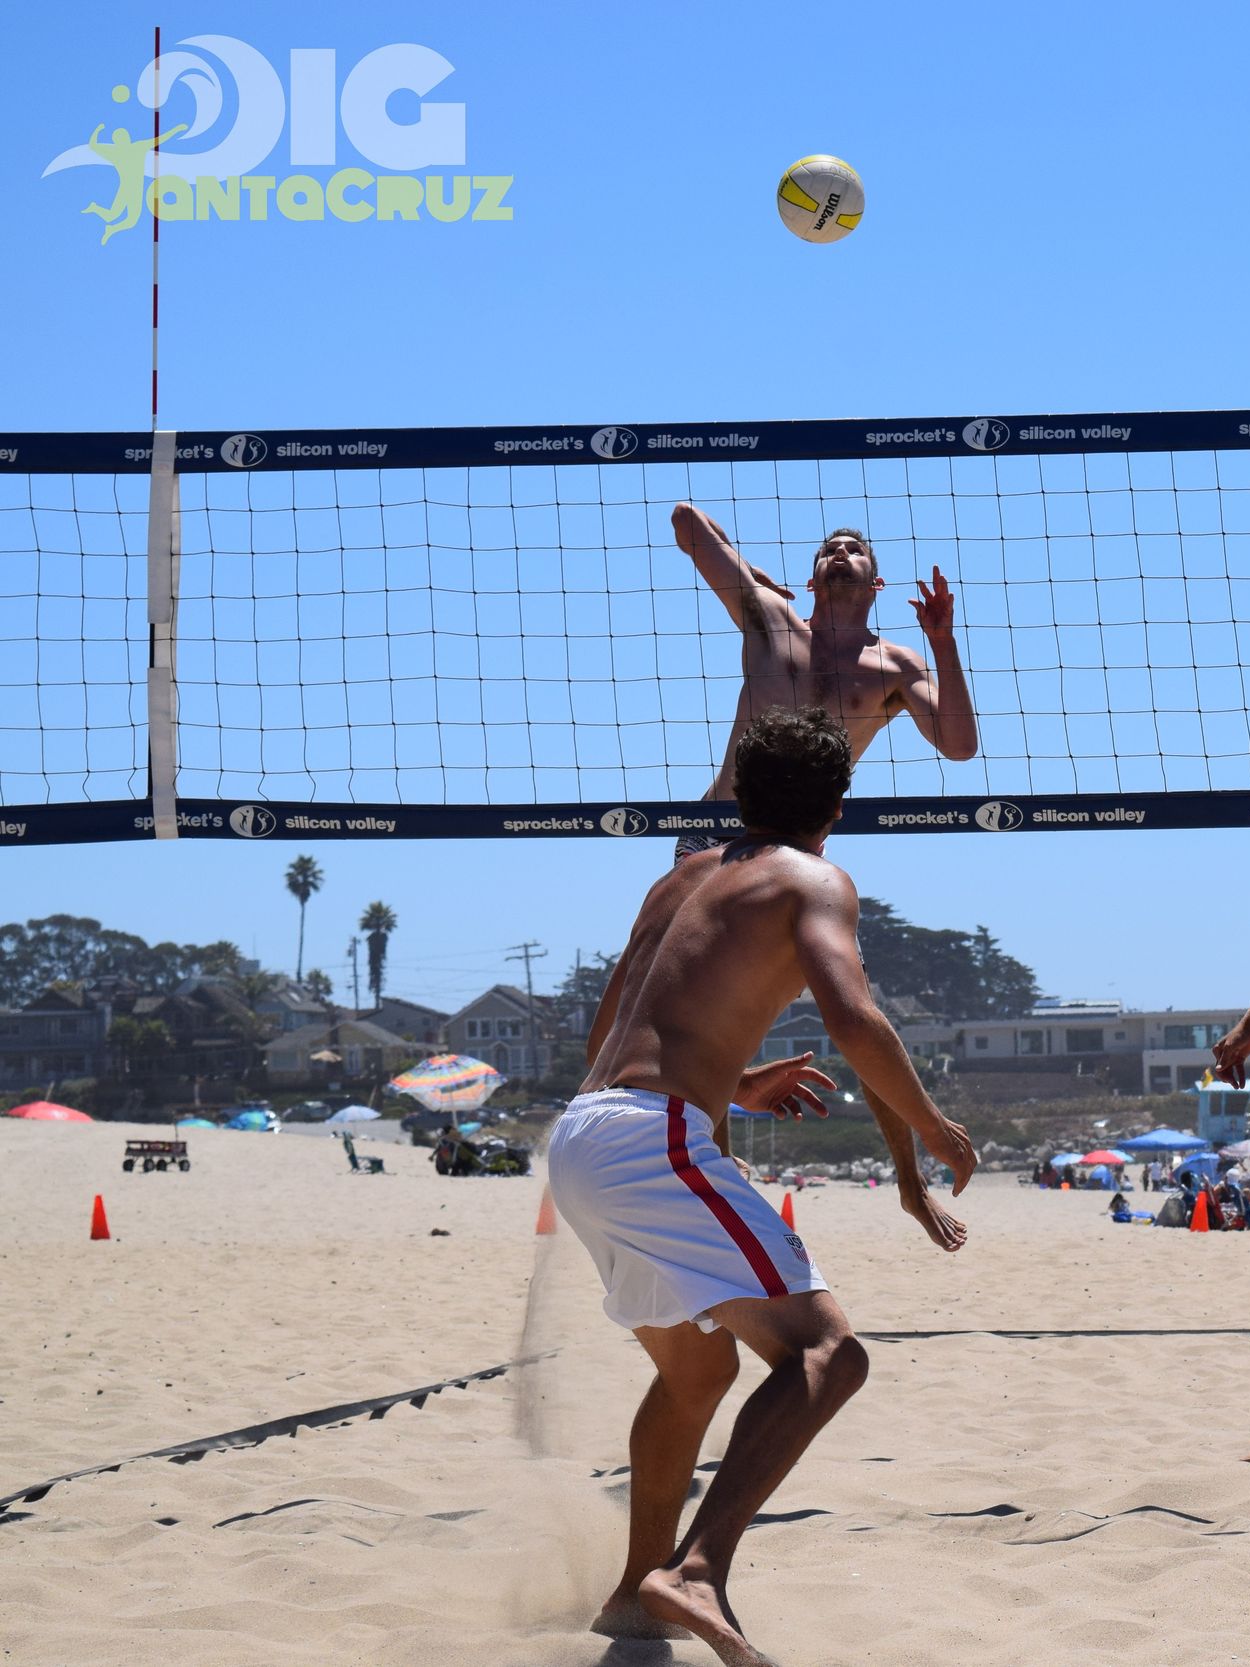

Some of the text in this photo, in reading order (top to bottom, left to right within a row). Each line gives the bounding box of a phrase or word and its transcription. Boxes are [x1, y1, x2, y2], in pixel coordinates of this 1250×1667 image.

[814, 193, 841, 231] Wilson
[494, 433, 759, 454] sprocket's silicon volley
[866, 425, 1132, 446] sprocket's silicon volley
[125, 441, 388, 461] sprket's silicon volley
[285, 815, 341, 830] silicon
[345, 816, 396, 833] volley
[503, 817, 595, 832] sprocket's
[657, 815, 715, 829] silicon
[877, 807, 1146, 828] sprocket's silicon volley
